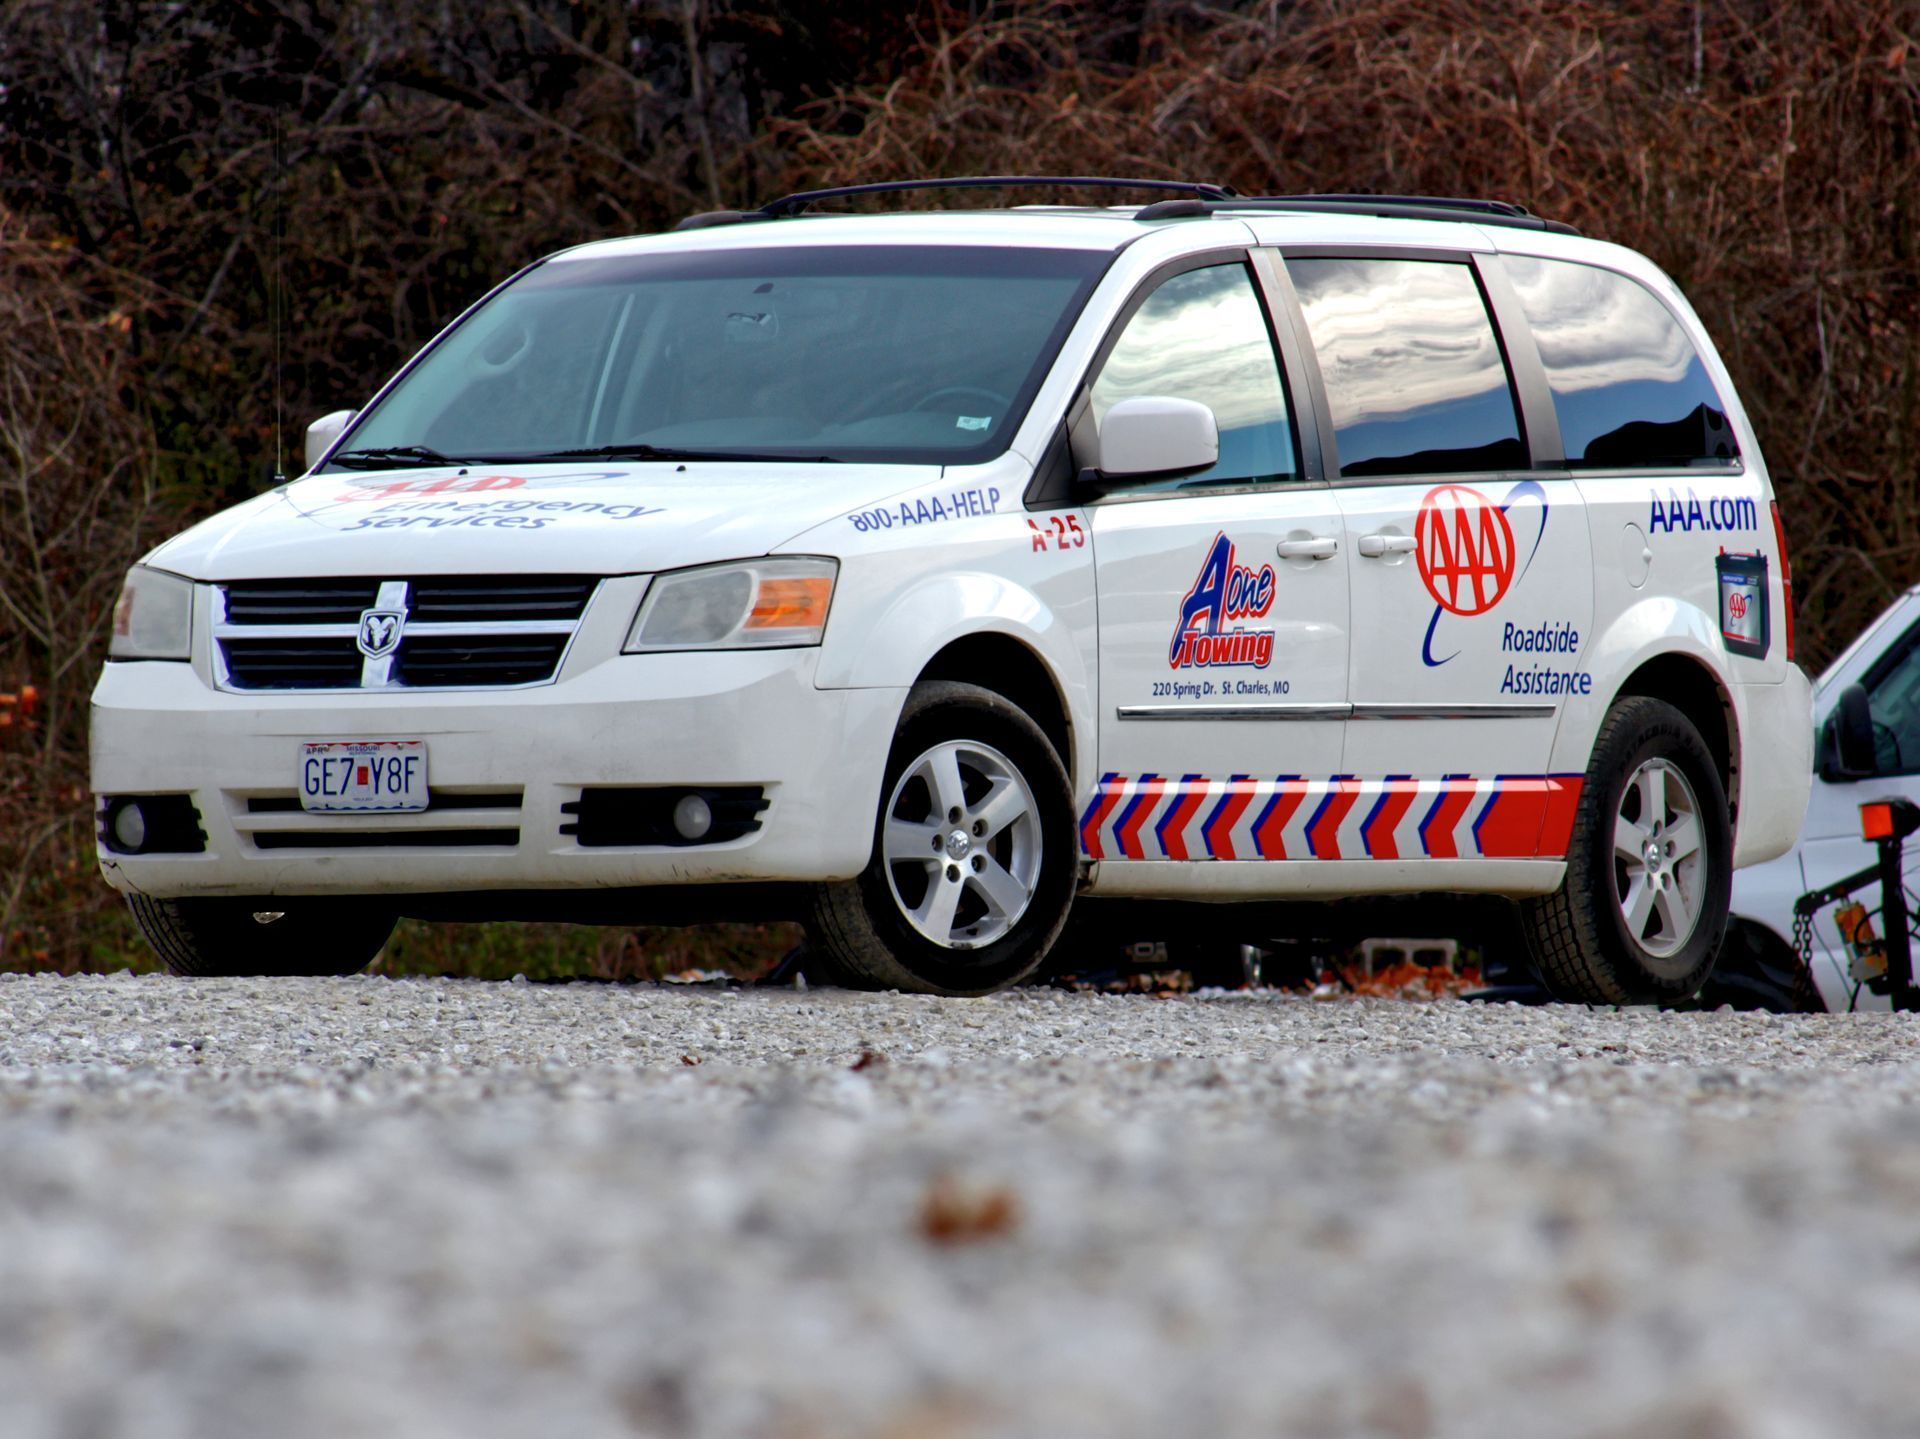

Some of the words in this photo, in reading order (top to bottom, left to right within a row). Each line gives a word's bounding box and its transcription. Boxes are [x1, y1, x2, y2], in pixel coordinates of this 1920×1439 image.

[340, 511, 557, 531] Services
[371, 500, 668, 520] Emergency
[848, 487, 1000, 532] 800-AAA-HELP
[1650, 487, 1757, 533] AAA.com
[1028, 514, 1084, 552] A-25
[1428, 487, 1505, 612] AAA
[1180, 627, 1275, 669] Towing
[1502, 621, 1578, 653] Roadside
[1153, 682, 1171, 696] 220
[1173, 681, 1201, 699] Spring
[1203, 681, 1217, 695] Dr.
[1222, 681, 1234, 695] St.
[1236, 680, 1271, 696] Charles,
[1273, 680, 1290, 694] MO
[1500, 664, 1592, 694] Assistance
[305, 758, 354, 796] GE7
[371, 756, 419, 795] Y8F
